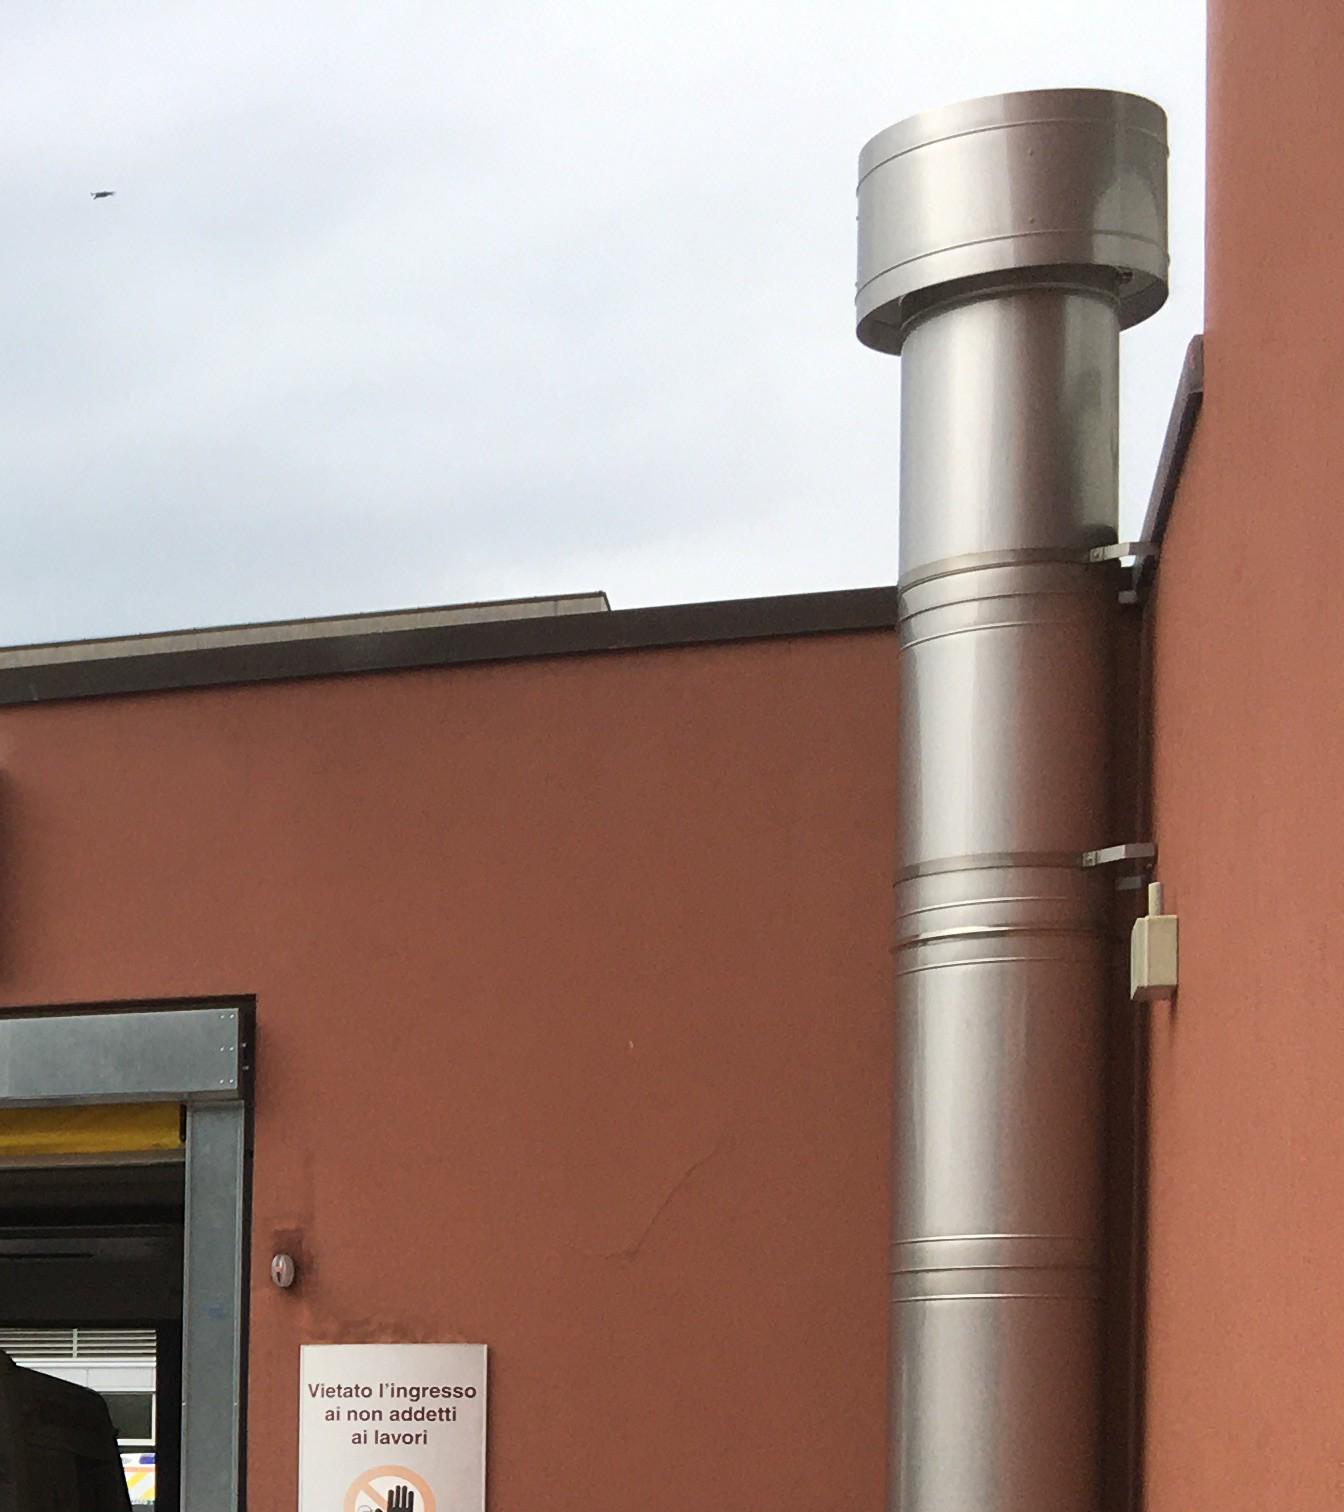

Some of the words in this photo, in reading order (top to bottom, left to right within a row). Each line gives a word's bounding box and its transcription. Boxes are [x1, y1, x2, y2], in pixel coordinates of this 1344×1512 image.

[307, 1383, 373, 1399] Vietato
[378, 1383, 478, 1402] l'ingresso
[324, 1406, 341, 1422] ai
[346, 1408, 383, 1422] non
[389, 1406, 457, 1422] addetti
[351, 1429, 368, 1445] ai
[374, 1429, 428, 1445] lavori
